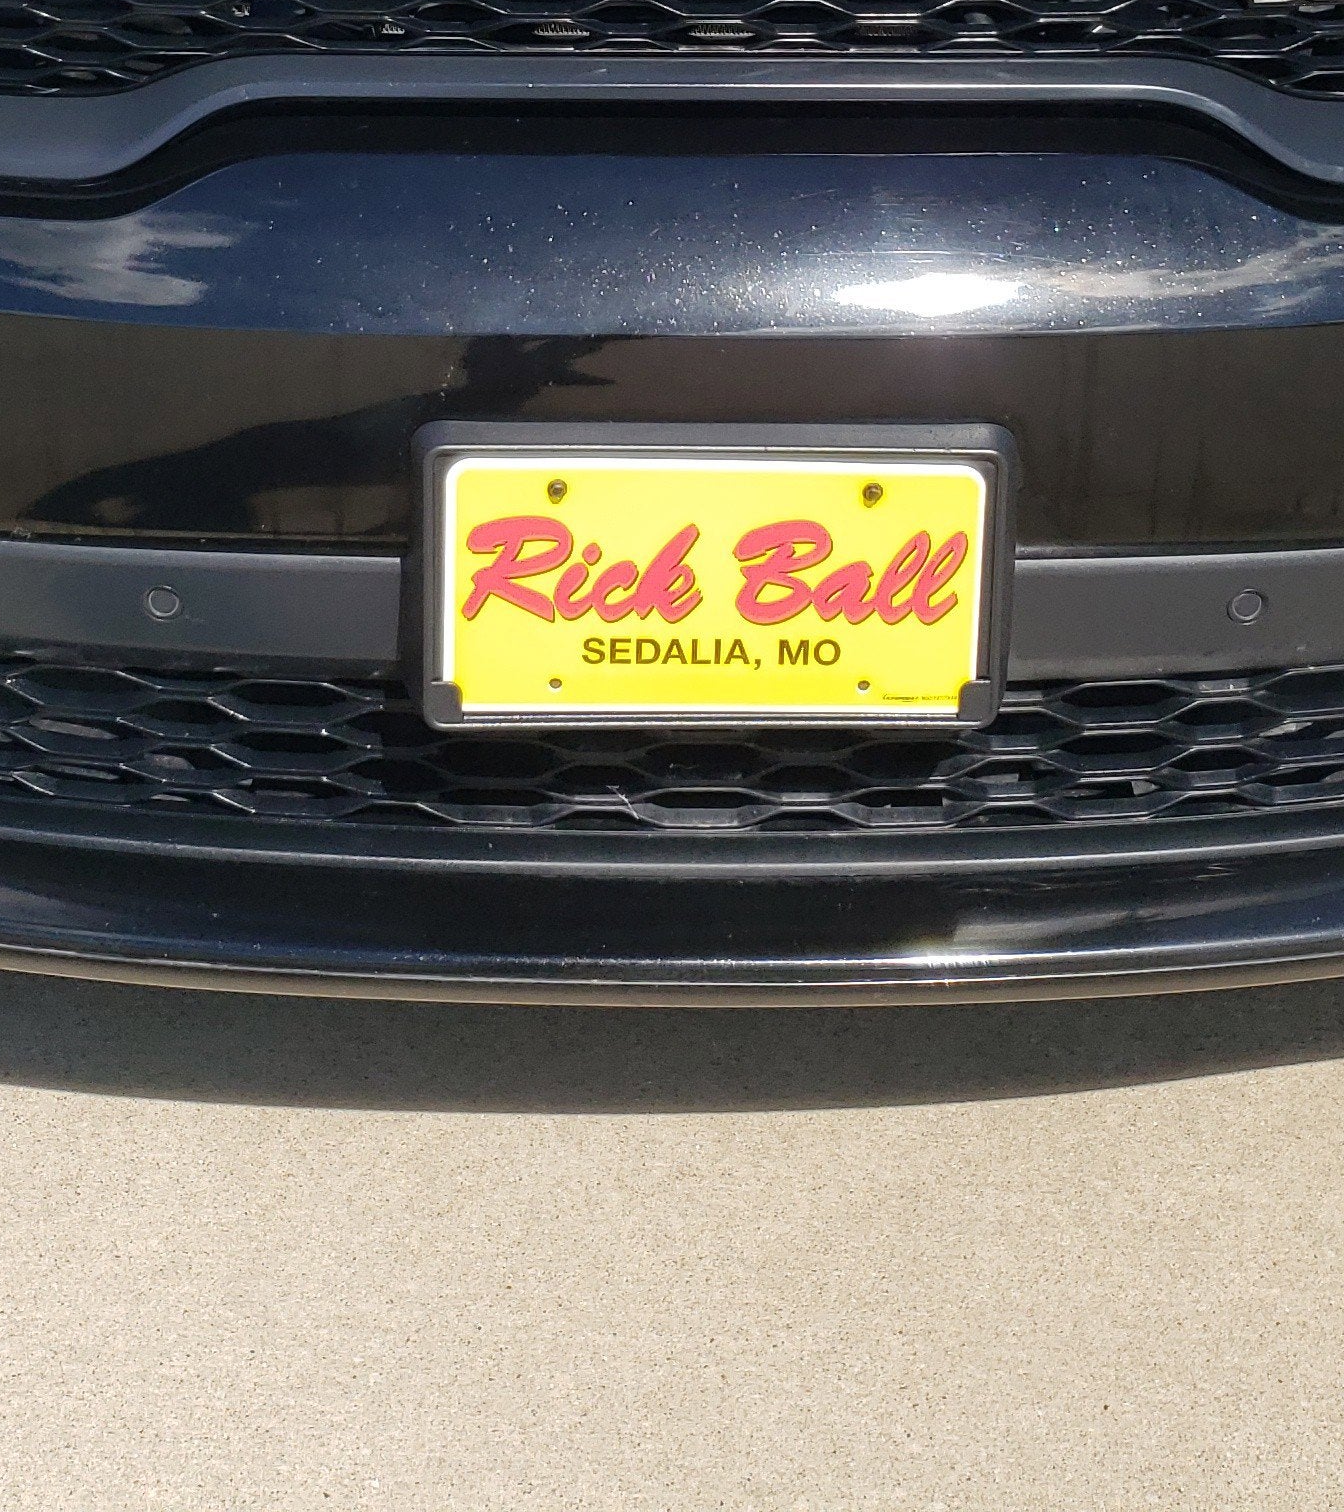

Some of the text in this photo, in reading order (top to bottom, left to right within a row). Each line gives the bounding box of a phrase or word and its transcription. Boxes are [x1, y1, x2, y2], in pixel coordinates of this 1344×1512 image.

[462, 515, 969, 627] Rick Ball
[581, 637, 842, 671] SEDALIA, MO
